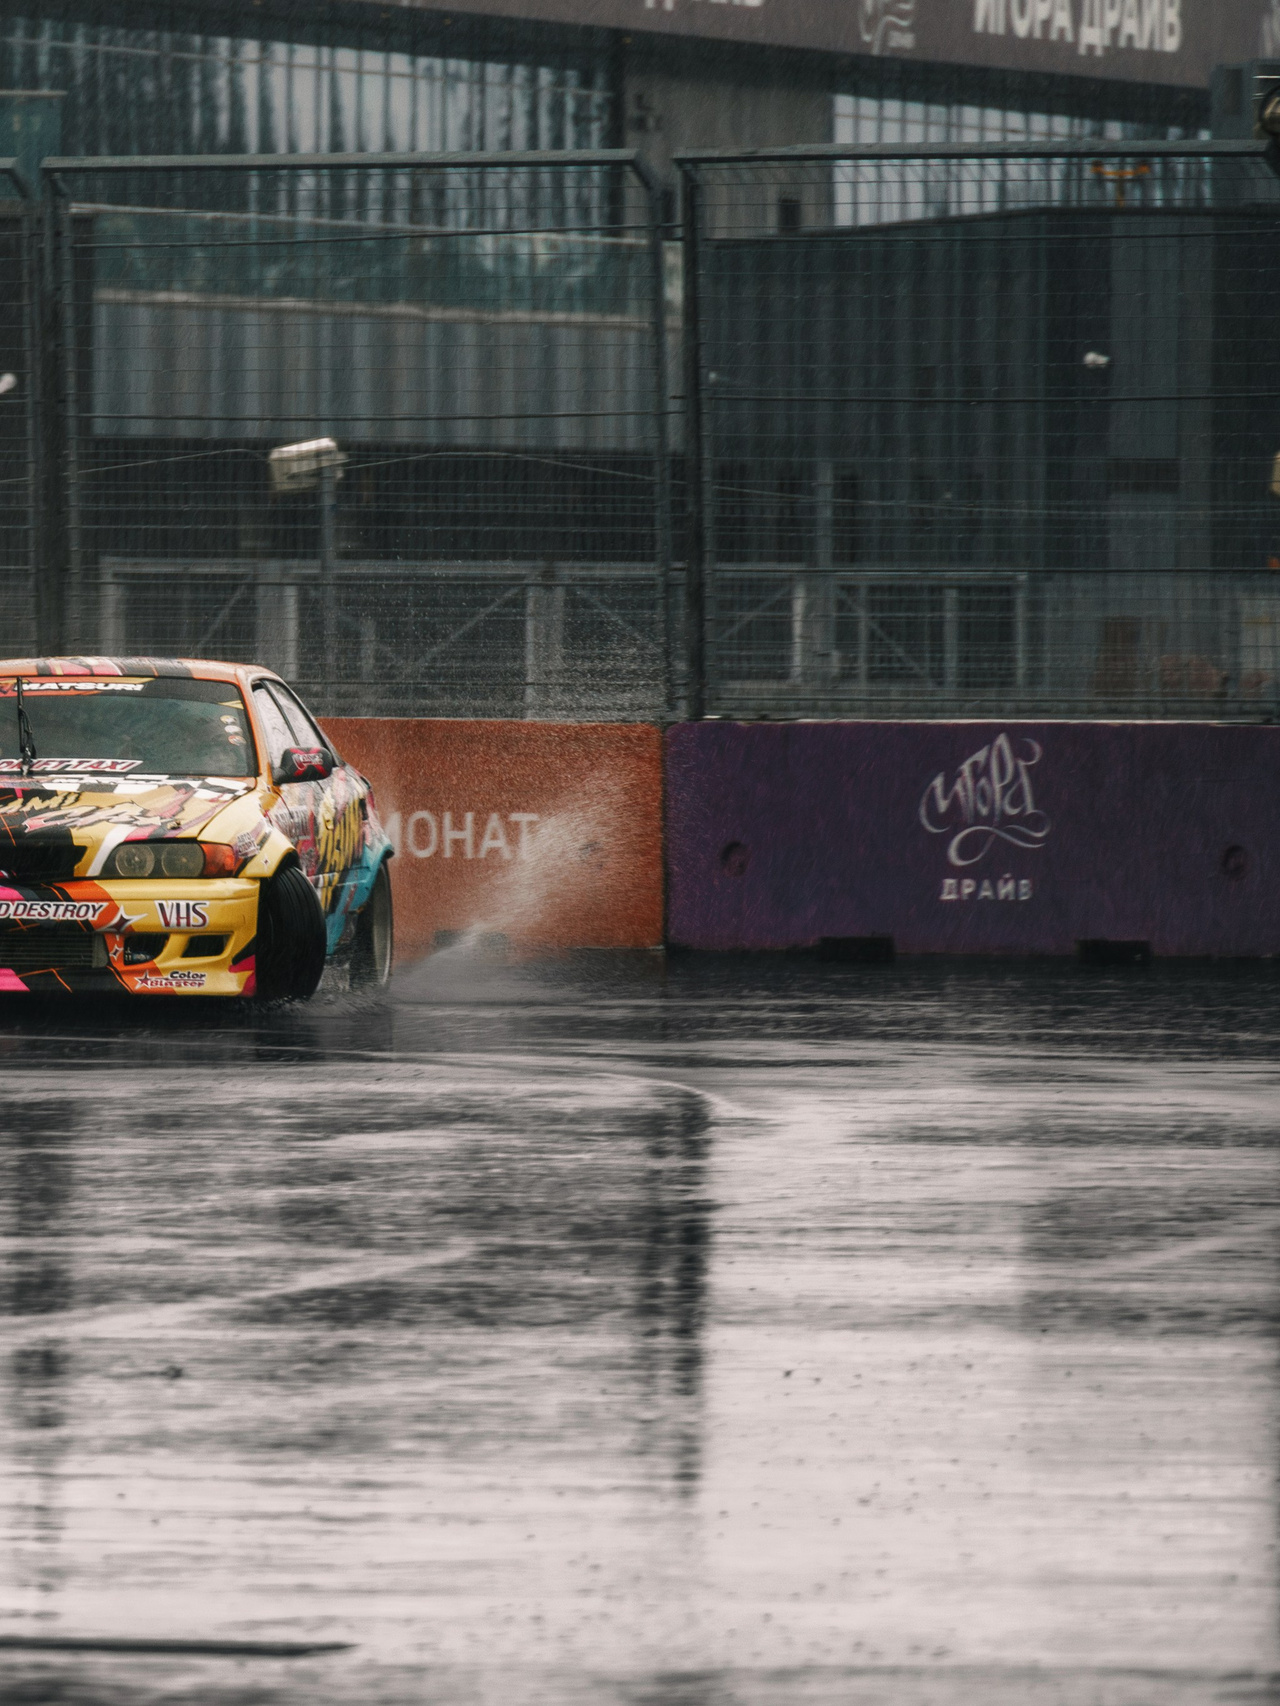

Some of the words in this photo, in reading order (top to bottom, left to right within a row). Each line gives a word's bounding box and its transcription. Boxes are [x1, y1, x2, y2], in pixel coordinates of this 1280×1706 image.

[14, 682, 146, 692] MATSURI
[69, 760, 140, 771] TAXI
[938, 873, 1032, 900] ДРАЙВ
[12, 902, 104, 919] DESTROY
[156, 901, 209, 928] VHS
[169, 970, 206, 979] Color
[149, 979, 205, 988] Blaster
